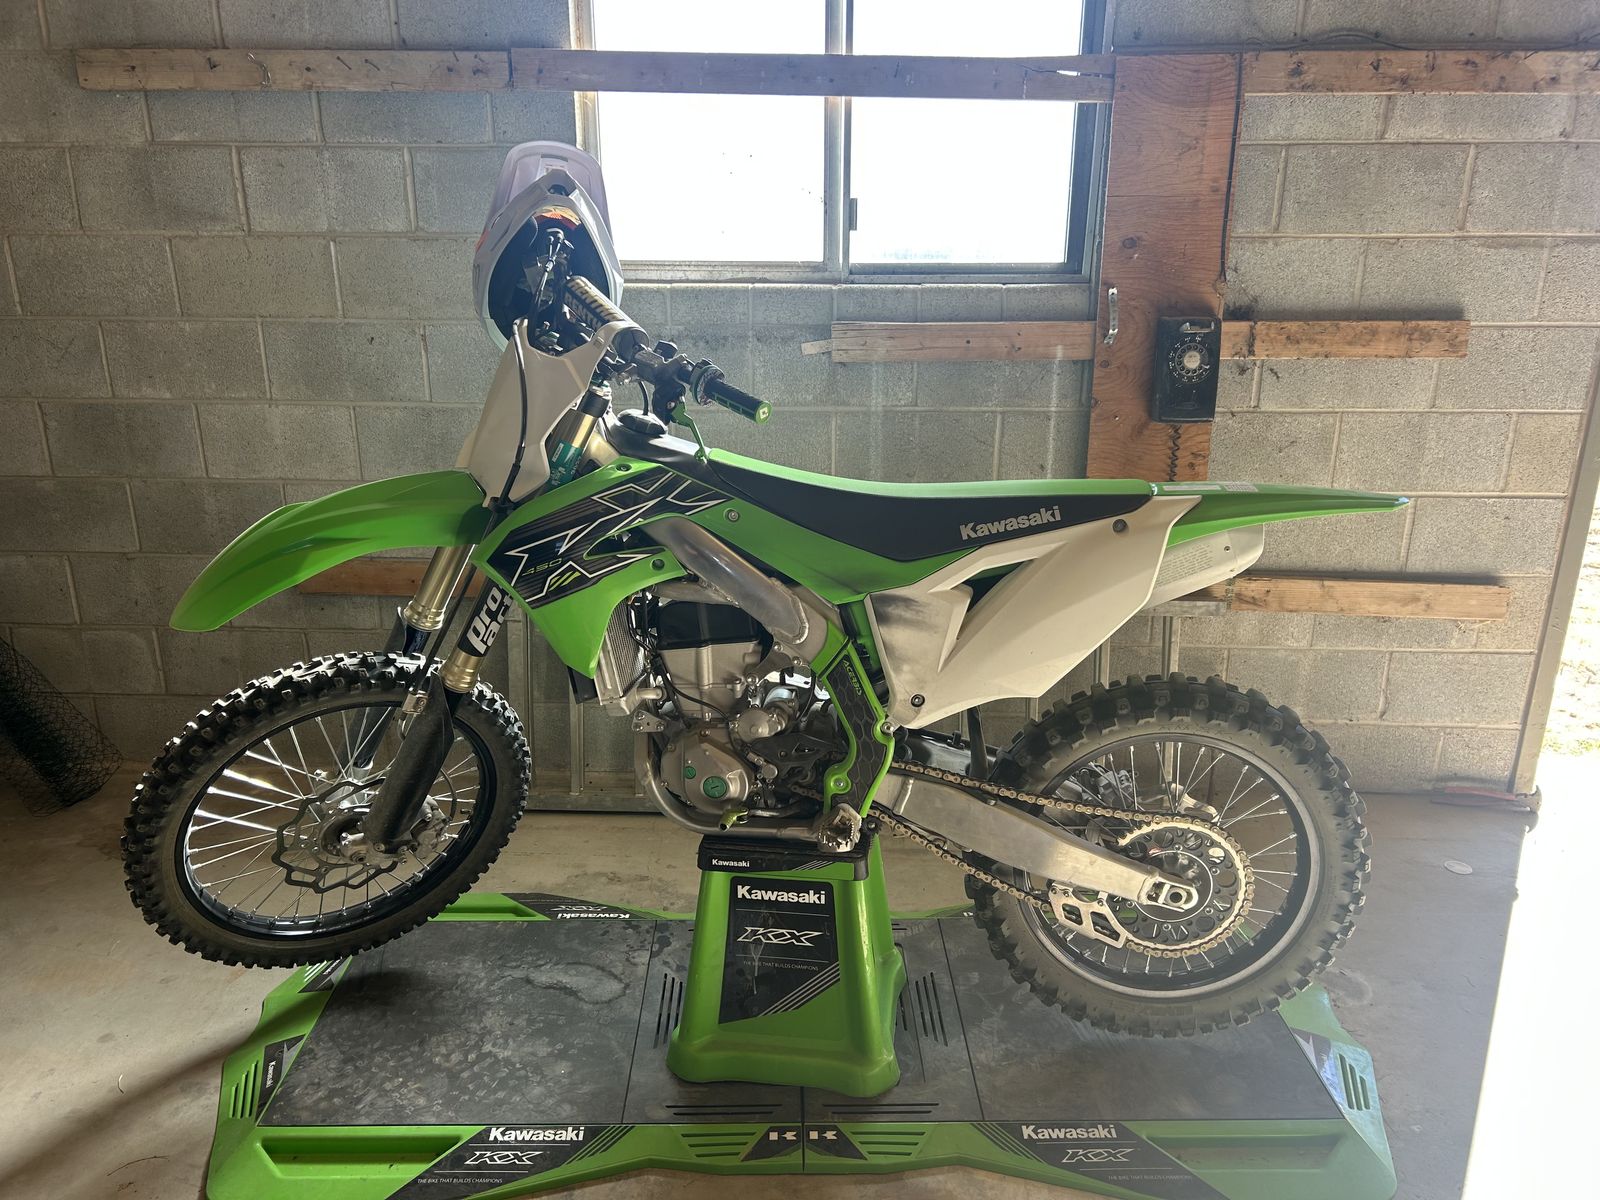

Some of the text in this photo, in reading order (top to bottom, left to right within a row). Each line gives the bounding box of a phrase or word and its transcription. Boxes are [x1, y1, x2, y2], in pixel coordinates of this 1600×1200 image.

[960, 505, 1061, 541] Kawasaki
[522, 558, 562, 577] 450
[712, 858, 750, 868] Kawasaki
[737, 885, 826, 905] Kawasaki
[737, 926, 823, 947] KX
[790, 963, 818, 971] CHAMPIONS
[488, 1126, 585, 1141] Kawasaki
[1021, 1124, 1117, 1140] Kawasaki
[463, 1151, 544, 1165] KX
[1061, 1148, 1136, 1163] KX
